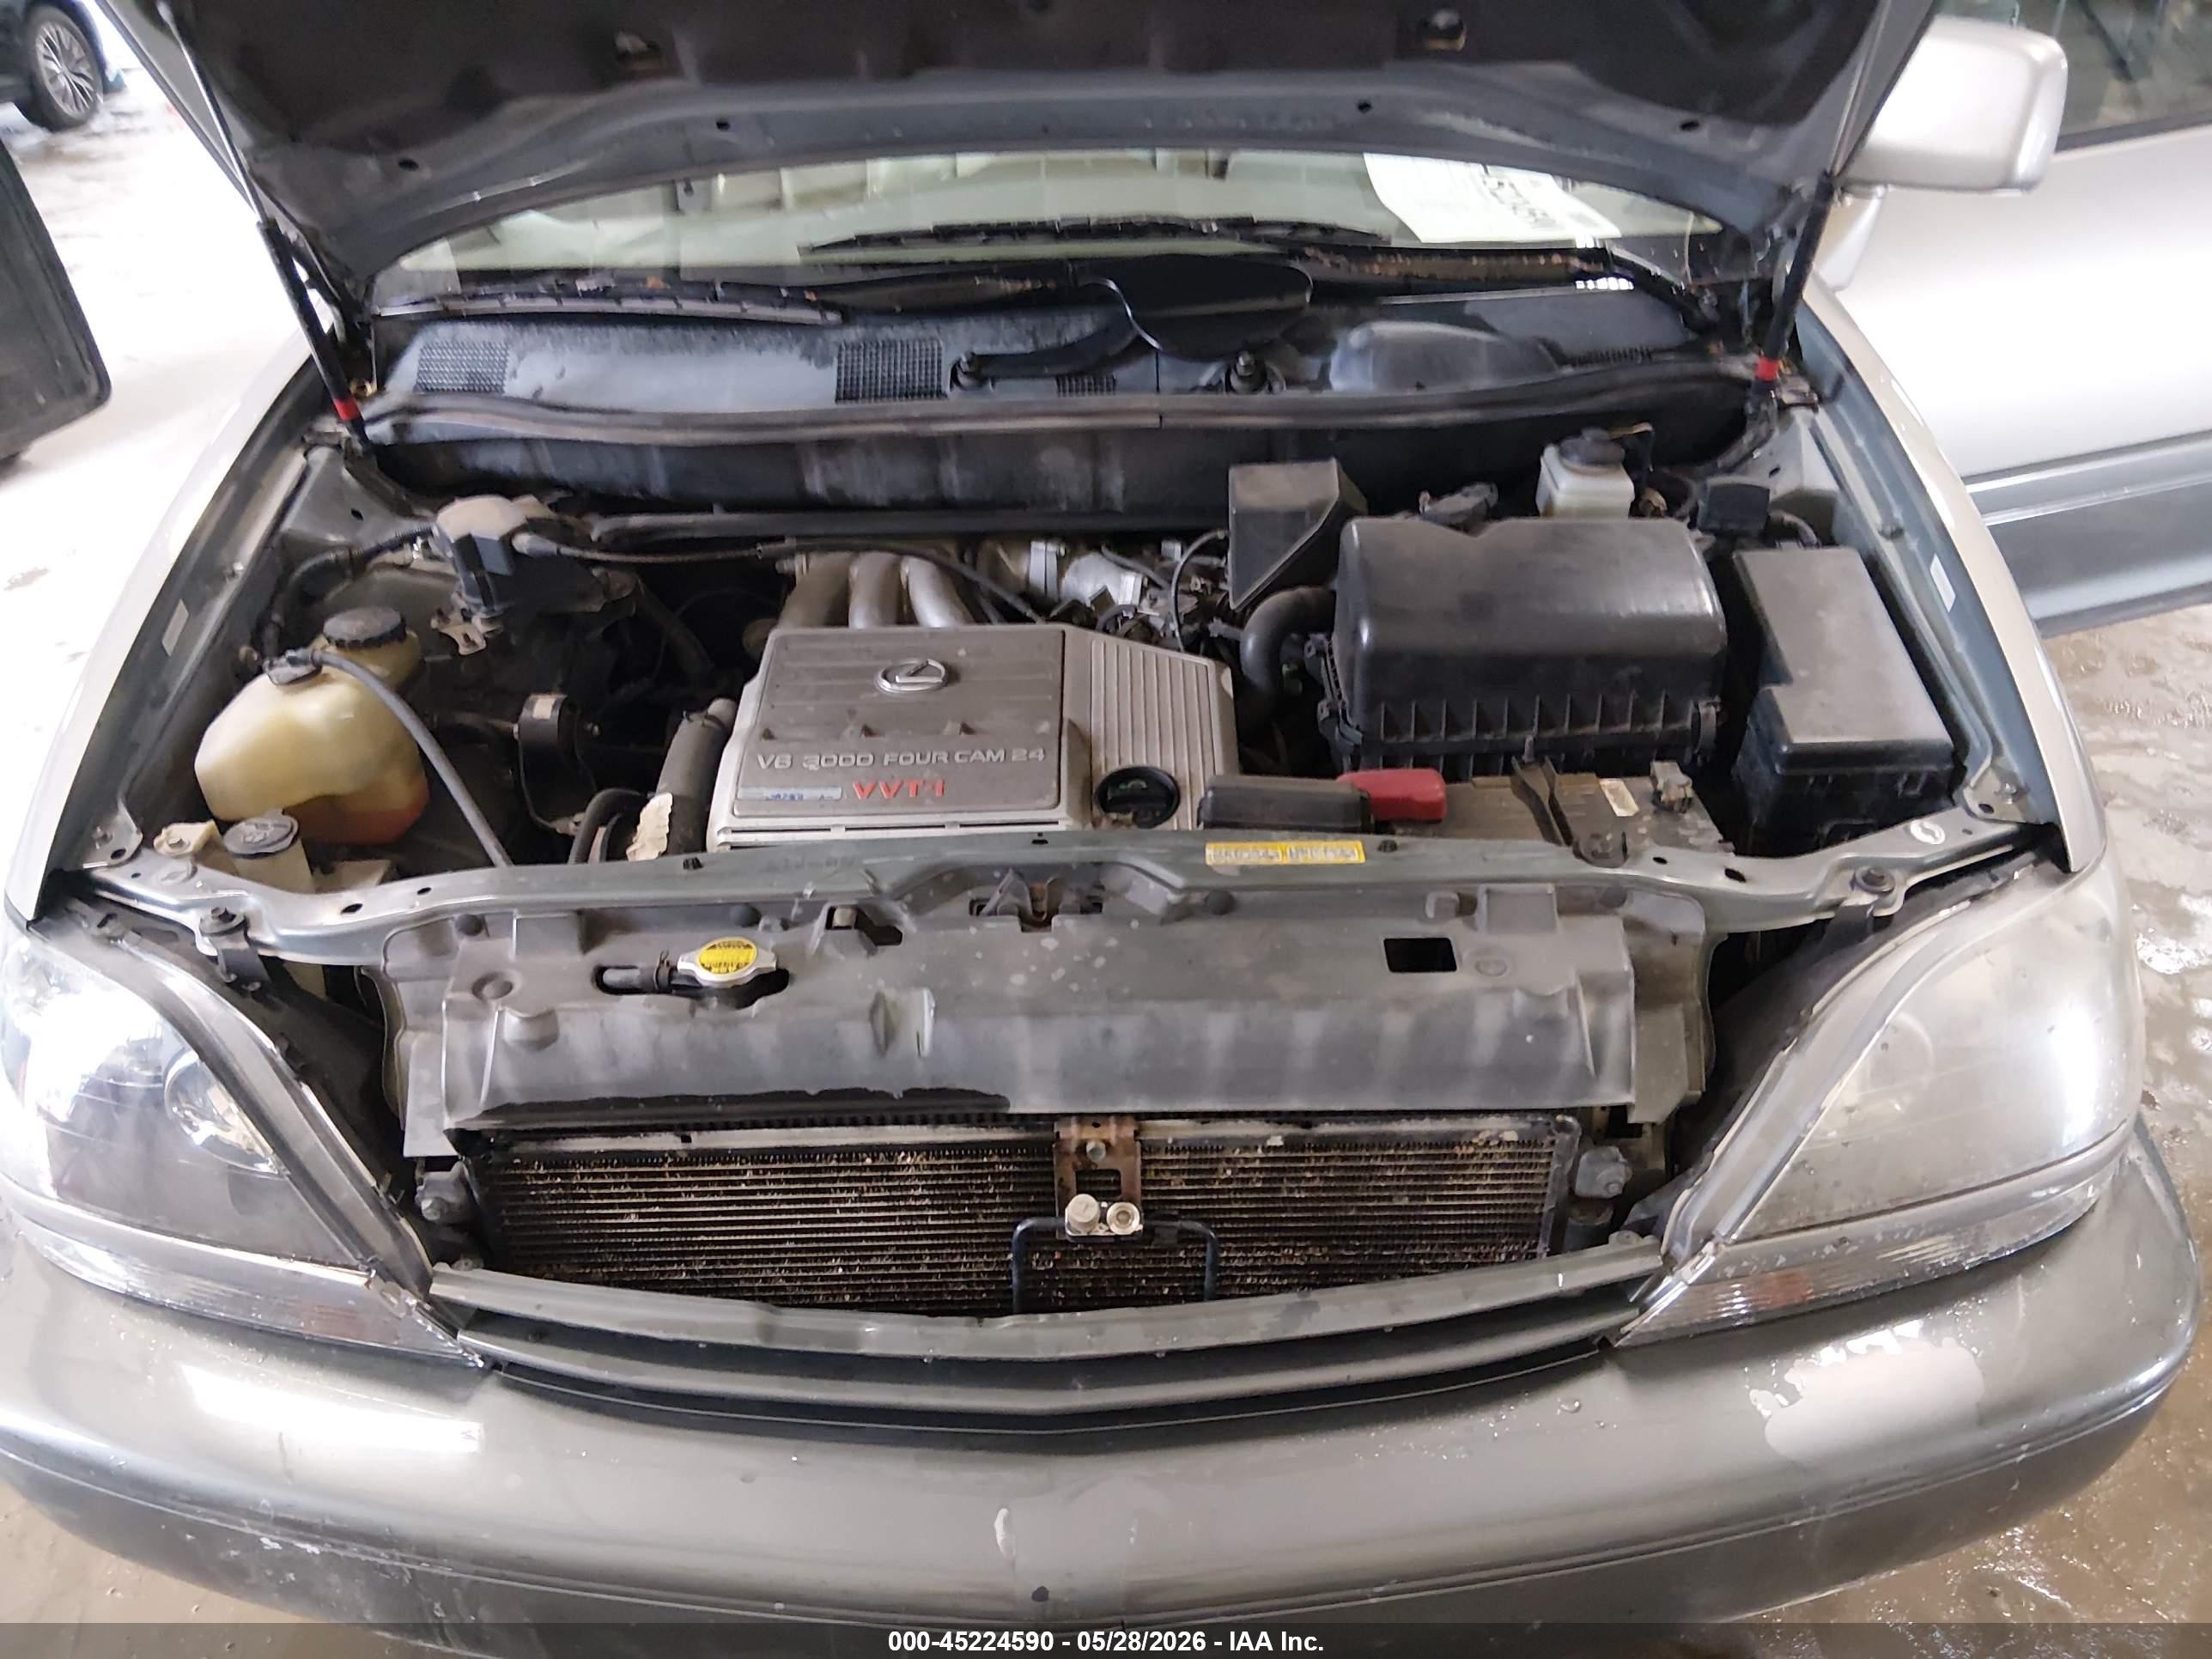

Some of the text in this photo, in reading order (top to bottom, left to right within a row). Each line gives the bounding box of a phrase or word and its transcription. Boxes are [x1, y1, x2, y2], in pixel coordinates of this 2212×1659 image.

[757, 748, 1046, 771] V6 3000 FOUR CAM 24
